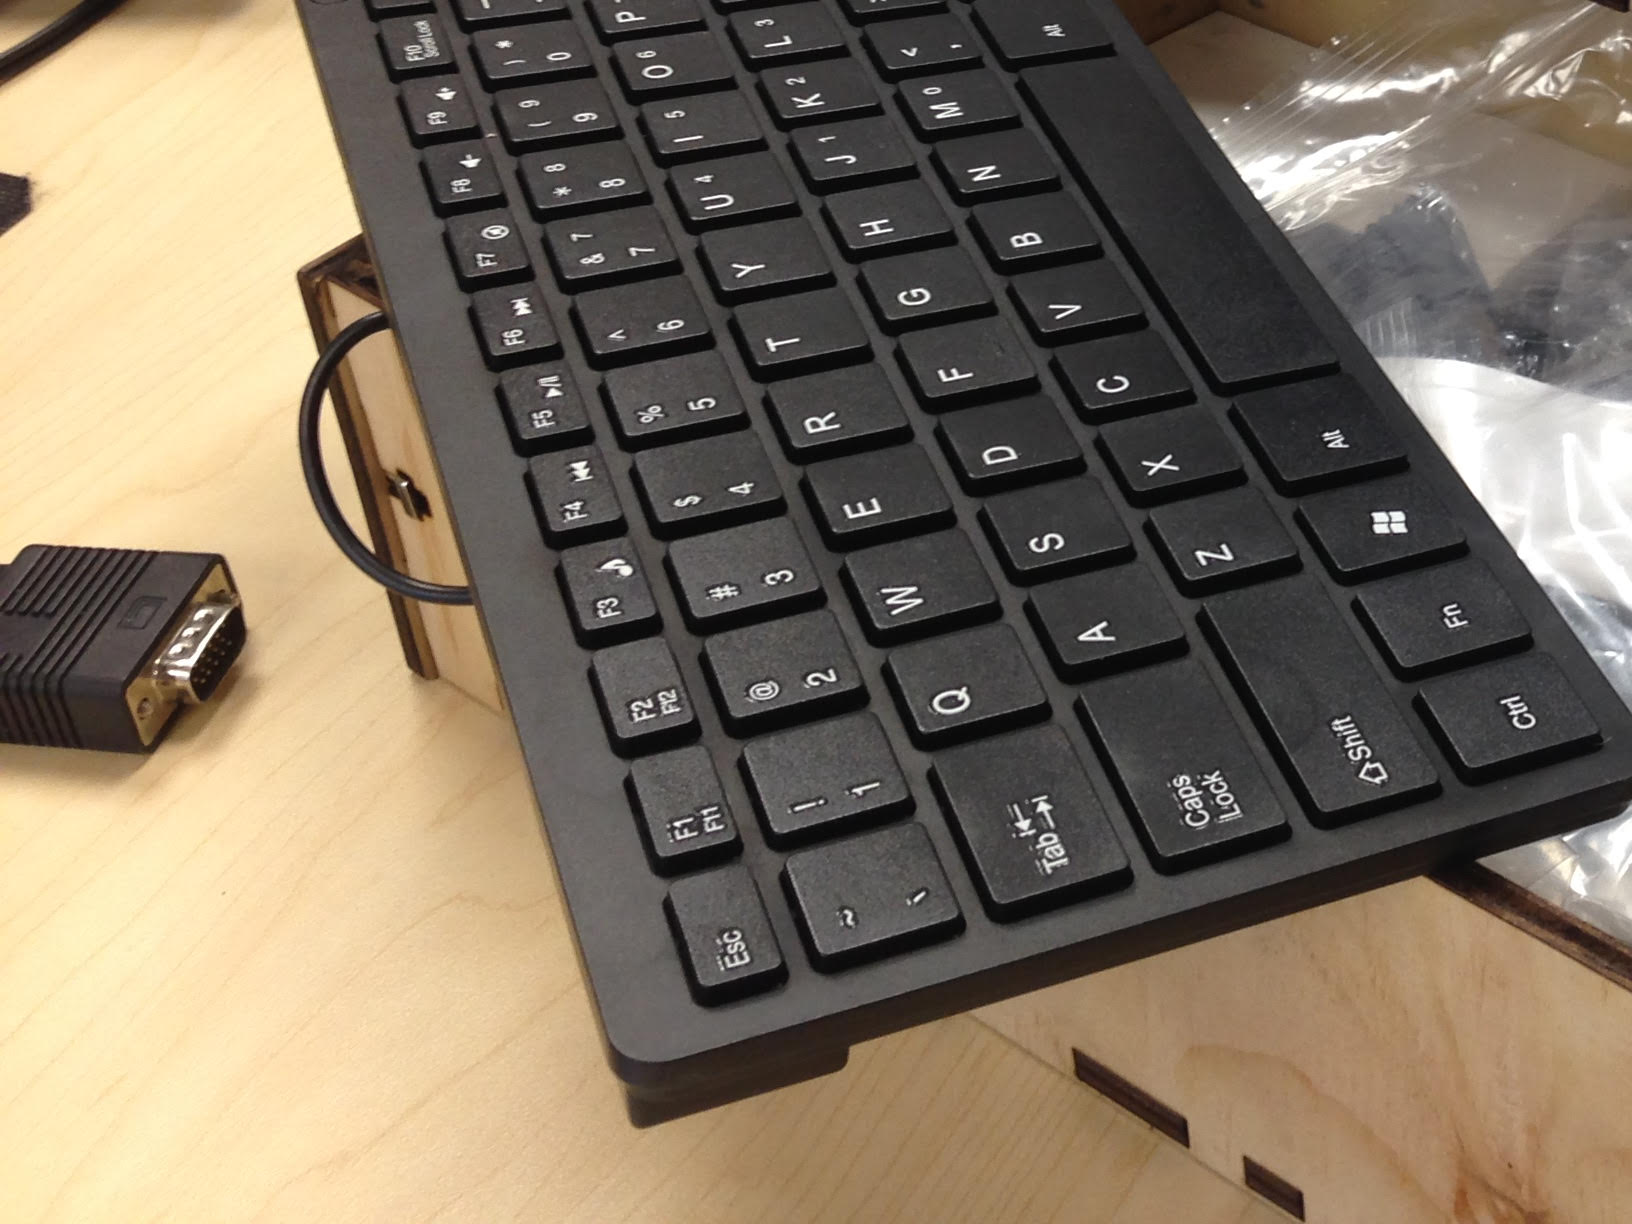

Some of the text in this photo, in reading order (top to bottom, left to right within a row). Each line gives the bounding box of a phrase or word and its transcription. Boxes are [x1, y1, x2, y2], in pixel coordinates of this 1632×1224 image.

[615, 11, 647, 23] P
[754, 18, 775, 27] 3
[1042, 23, 1066, 37] Alt
[764, 35, 793, 48] L
[403, 44, 423, 62] F10
[546, 51, 572, 61] 0
[636, 50, 657, 59] 6
[900, 47, 918, 57] <
[641, 64, 674, 79] O
[785, 76, 806, 86] 2
[791, 92, 825, 109] K
[427, 111, 448, 126] F9
[572, 112, 598, 123] 9
[663, 110, 686, 119] 5
[929, 101, 964, 119] M
[817, 135, 836, 143] 1
[824, 154, 857, 164] J
[543, 163, 566, 173] 8
[967, 165, 1001, 182] N
[450, 178, 473, 194] F8
[598, 178, 626, 189] 8
[694, 174, 713, 183] 4
[700, 194, 735, 210] U
[859, 219, 894, 237] H
[570, 233, 593, 242] 7
[1009, 232, 1043, 248] B
[579, 252, 605, 265] &
[628, 246, 655, 257] 7
[475, 253, 498, 268] F7
[731, 263, 765, 278] Y
[897, 287, 931, 306] G
[1048, 304, 1082, 320] V
[657, 319, 685, 331] 6
[502, 329, 525, 346] F6
[765, 337, 800, 353] T
[937, 367, 974, 383] F
[1096, 375, 1130, 394] C
[688, 397, 716, 411] 5
[531, 409, 556, 429] F5
[637, 405, 664, 424] %
[804, 411, 841, 434] R
[1322, 429, 1350, 449] Alt
[982, 445, 1018, 466] D
[1141, 454, 1180, 476] X
[728, 482, 754, 495] 4
[673, 495, 702, 508] $
[842, 497, 882, 520] E
[563, 501, 588, 523] F4
[1028, 532, 1065, 553] S
[1194, 543, 1234, 566] Z
[764, 569, 794, 586] 3
[709, 584, 739, 600] #
[596, 597, 622, 619] F3
[880, 586, 924, 616] W
[1442, 603, 1469, 629] Fn
[1077, 621, 1116, 642] A
[803, 668, 837, 689] 2
[745, 680, 780, 703] @
[657, 689, 681, 715] F12
[932, 686, 971, 715] Q
[630, 698, 657, 724] F2
[1500, 695, 1537, 730] Ctrl
[1331, 715, 1372, 761] Shift
[851, 782, 880, 796] 1
[793, 799, 825, 812] !
[1172, 773, 1215, 830] Caps
[1197, 770, 1243, 827] Lock
[700, 806, 725, 833] F11
[672, 817, 699, 841] F1
[1035, 832, 1069, 875] Tab
[836, 909, 855, 926] ~
[722, 930, 751, 969] Esc
